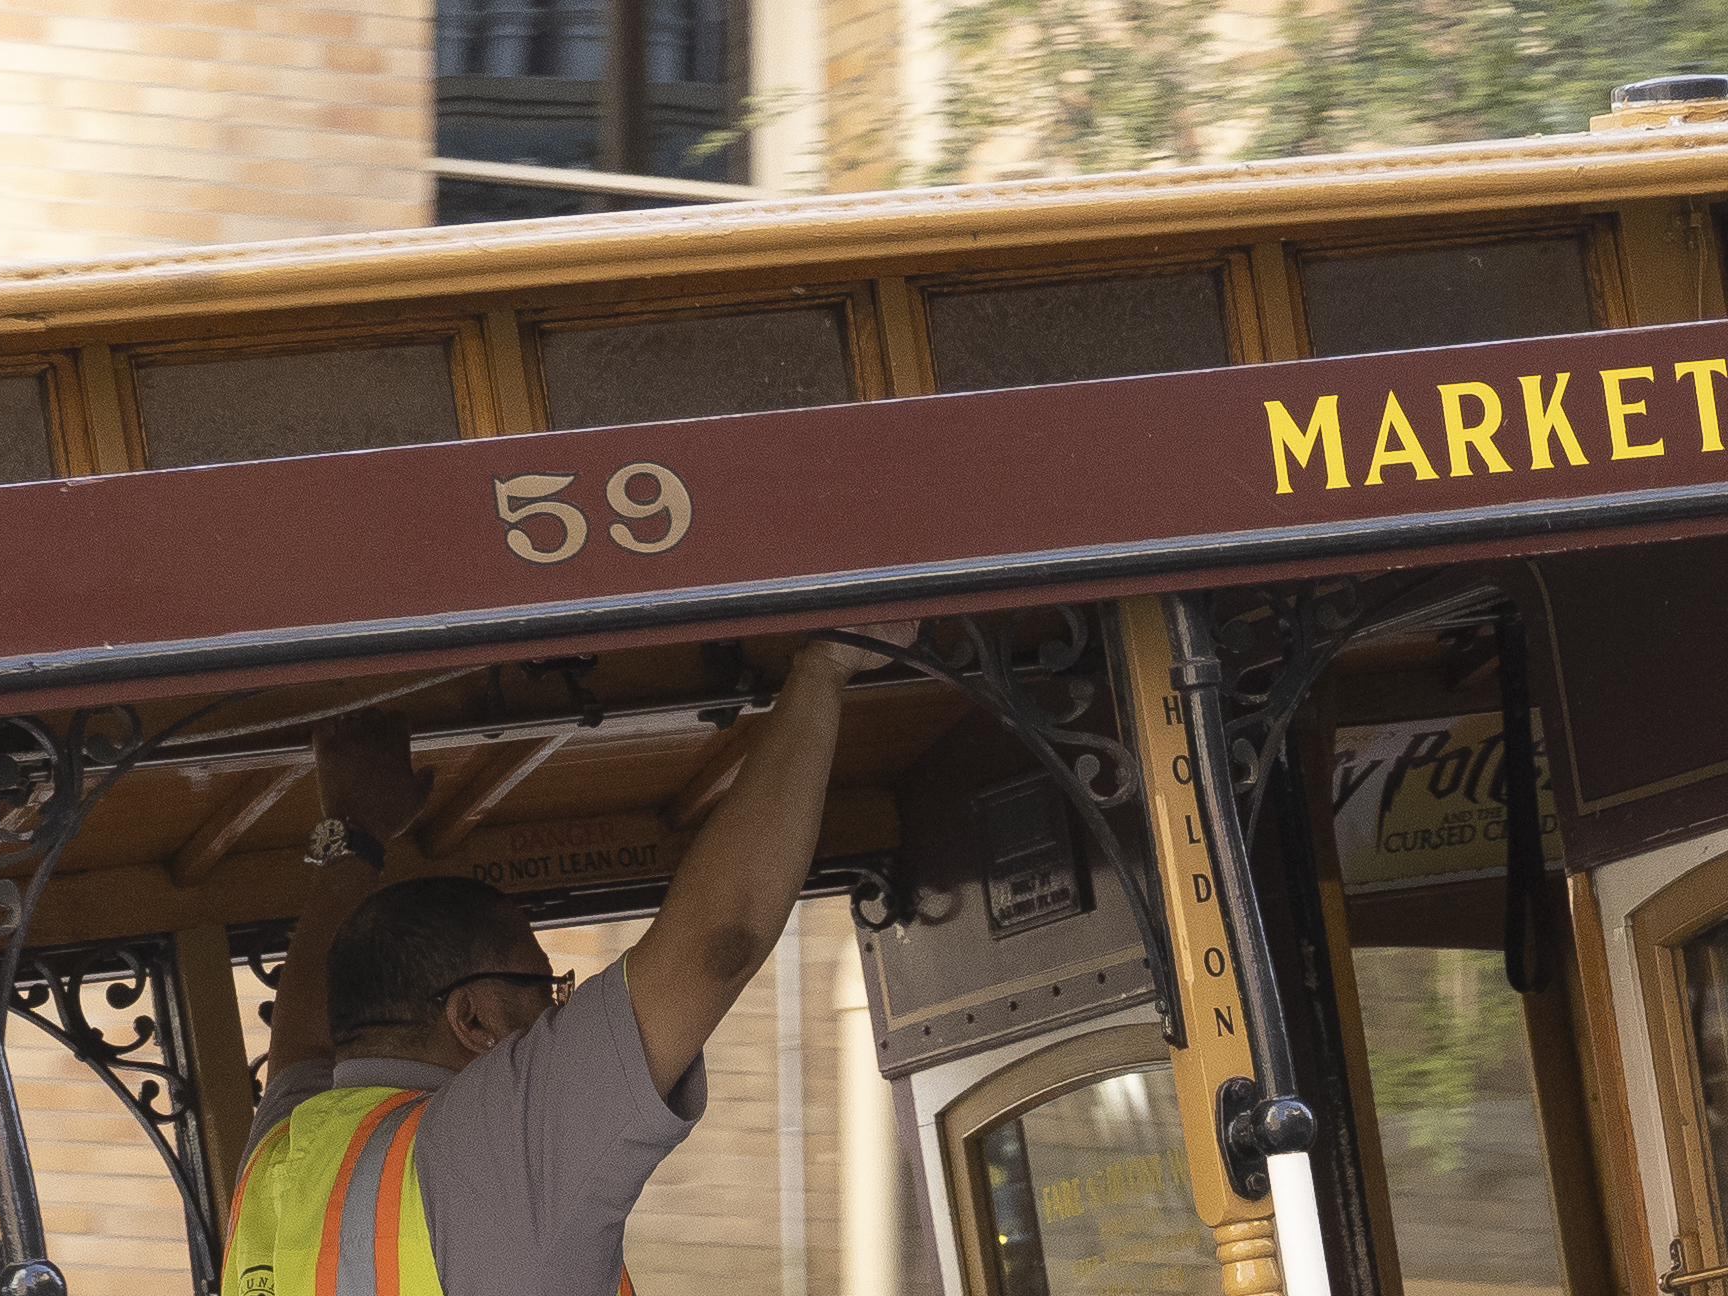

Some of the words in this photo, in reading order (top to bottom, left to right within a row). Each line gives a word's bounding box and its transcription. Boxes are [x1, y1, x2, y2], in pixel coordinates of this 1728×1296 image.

[491, 461, 695, 567] 59
[1383, 824, 1476, 854] CURSED
[508, 856, 552, 881] NOT
[558, 851, 614, 876] LEAN
[617, 843, 658, 867] OUT
